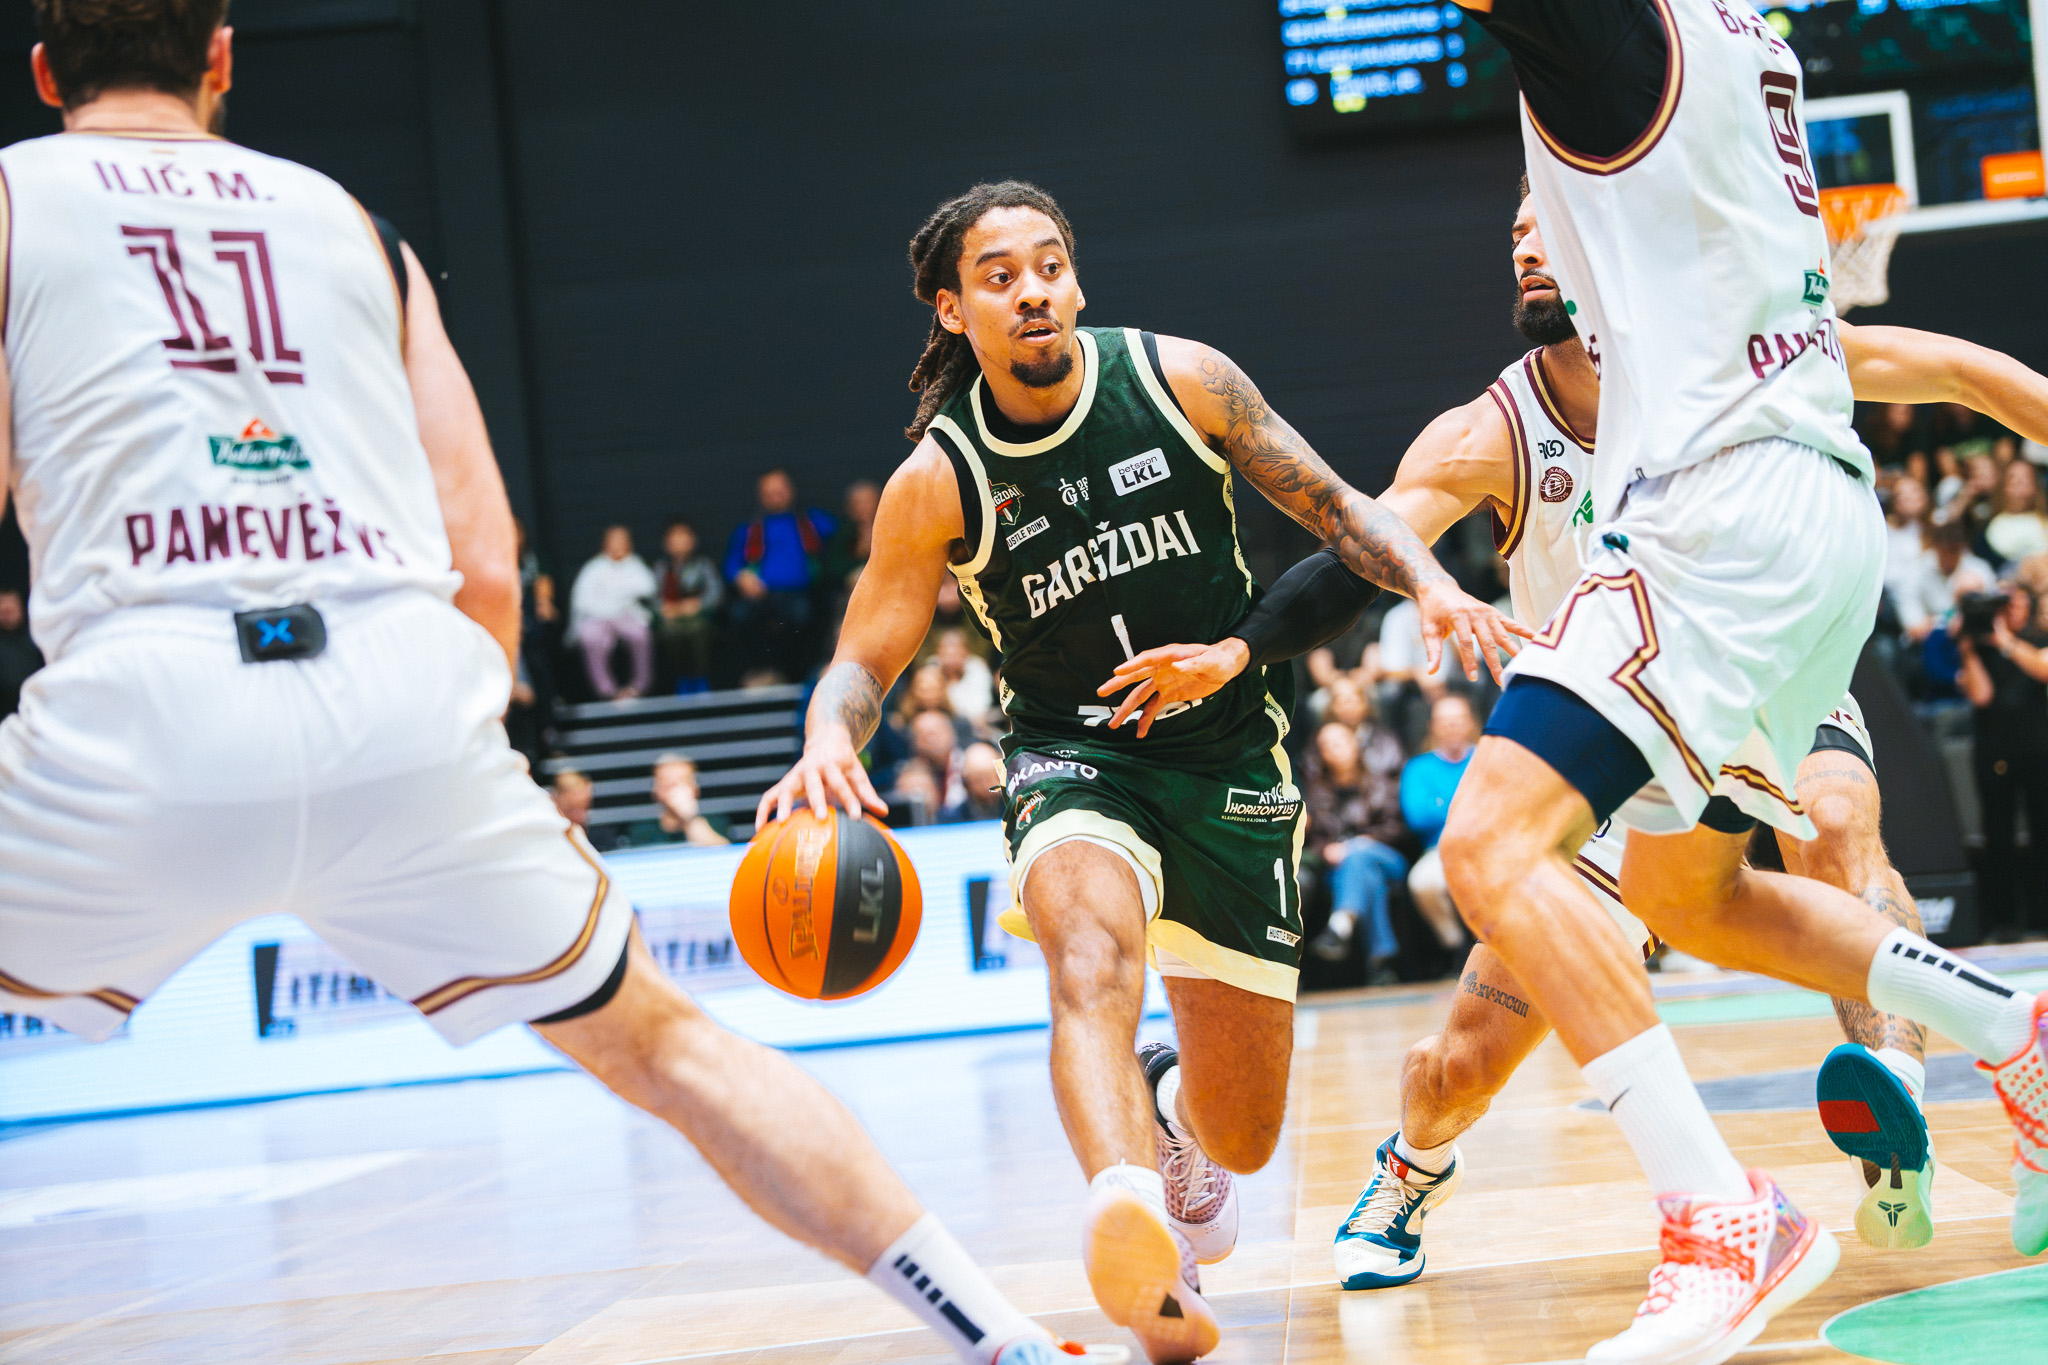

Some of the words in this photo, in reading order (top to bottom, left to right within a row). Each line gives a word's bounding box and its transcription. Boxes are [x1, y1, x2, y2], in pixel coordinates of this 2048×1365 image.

[120, 224, 304, 385] 11
[1117, 456, 1158, 476] betsson
[1120, 464, 1162, 489] LKL
[1027, 518, 1047, 537] POINT
[1229, 802, 1294, 816] HORIZONTUS
[852, 857, 885, 944] LKL
[1273, 857, 1287, 919] 1
